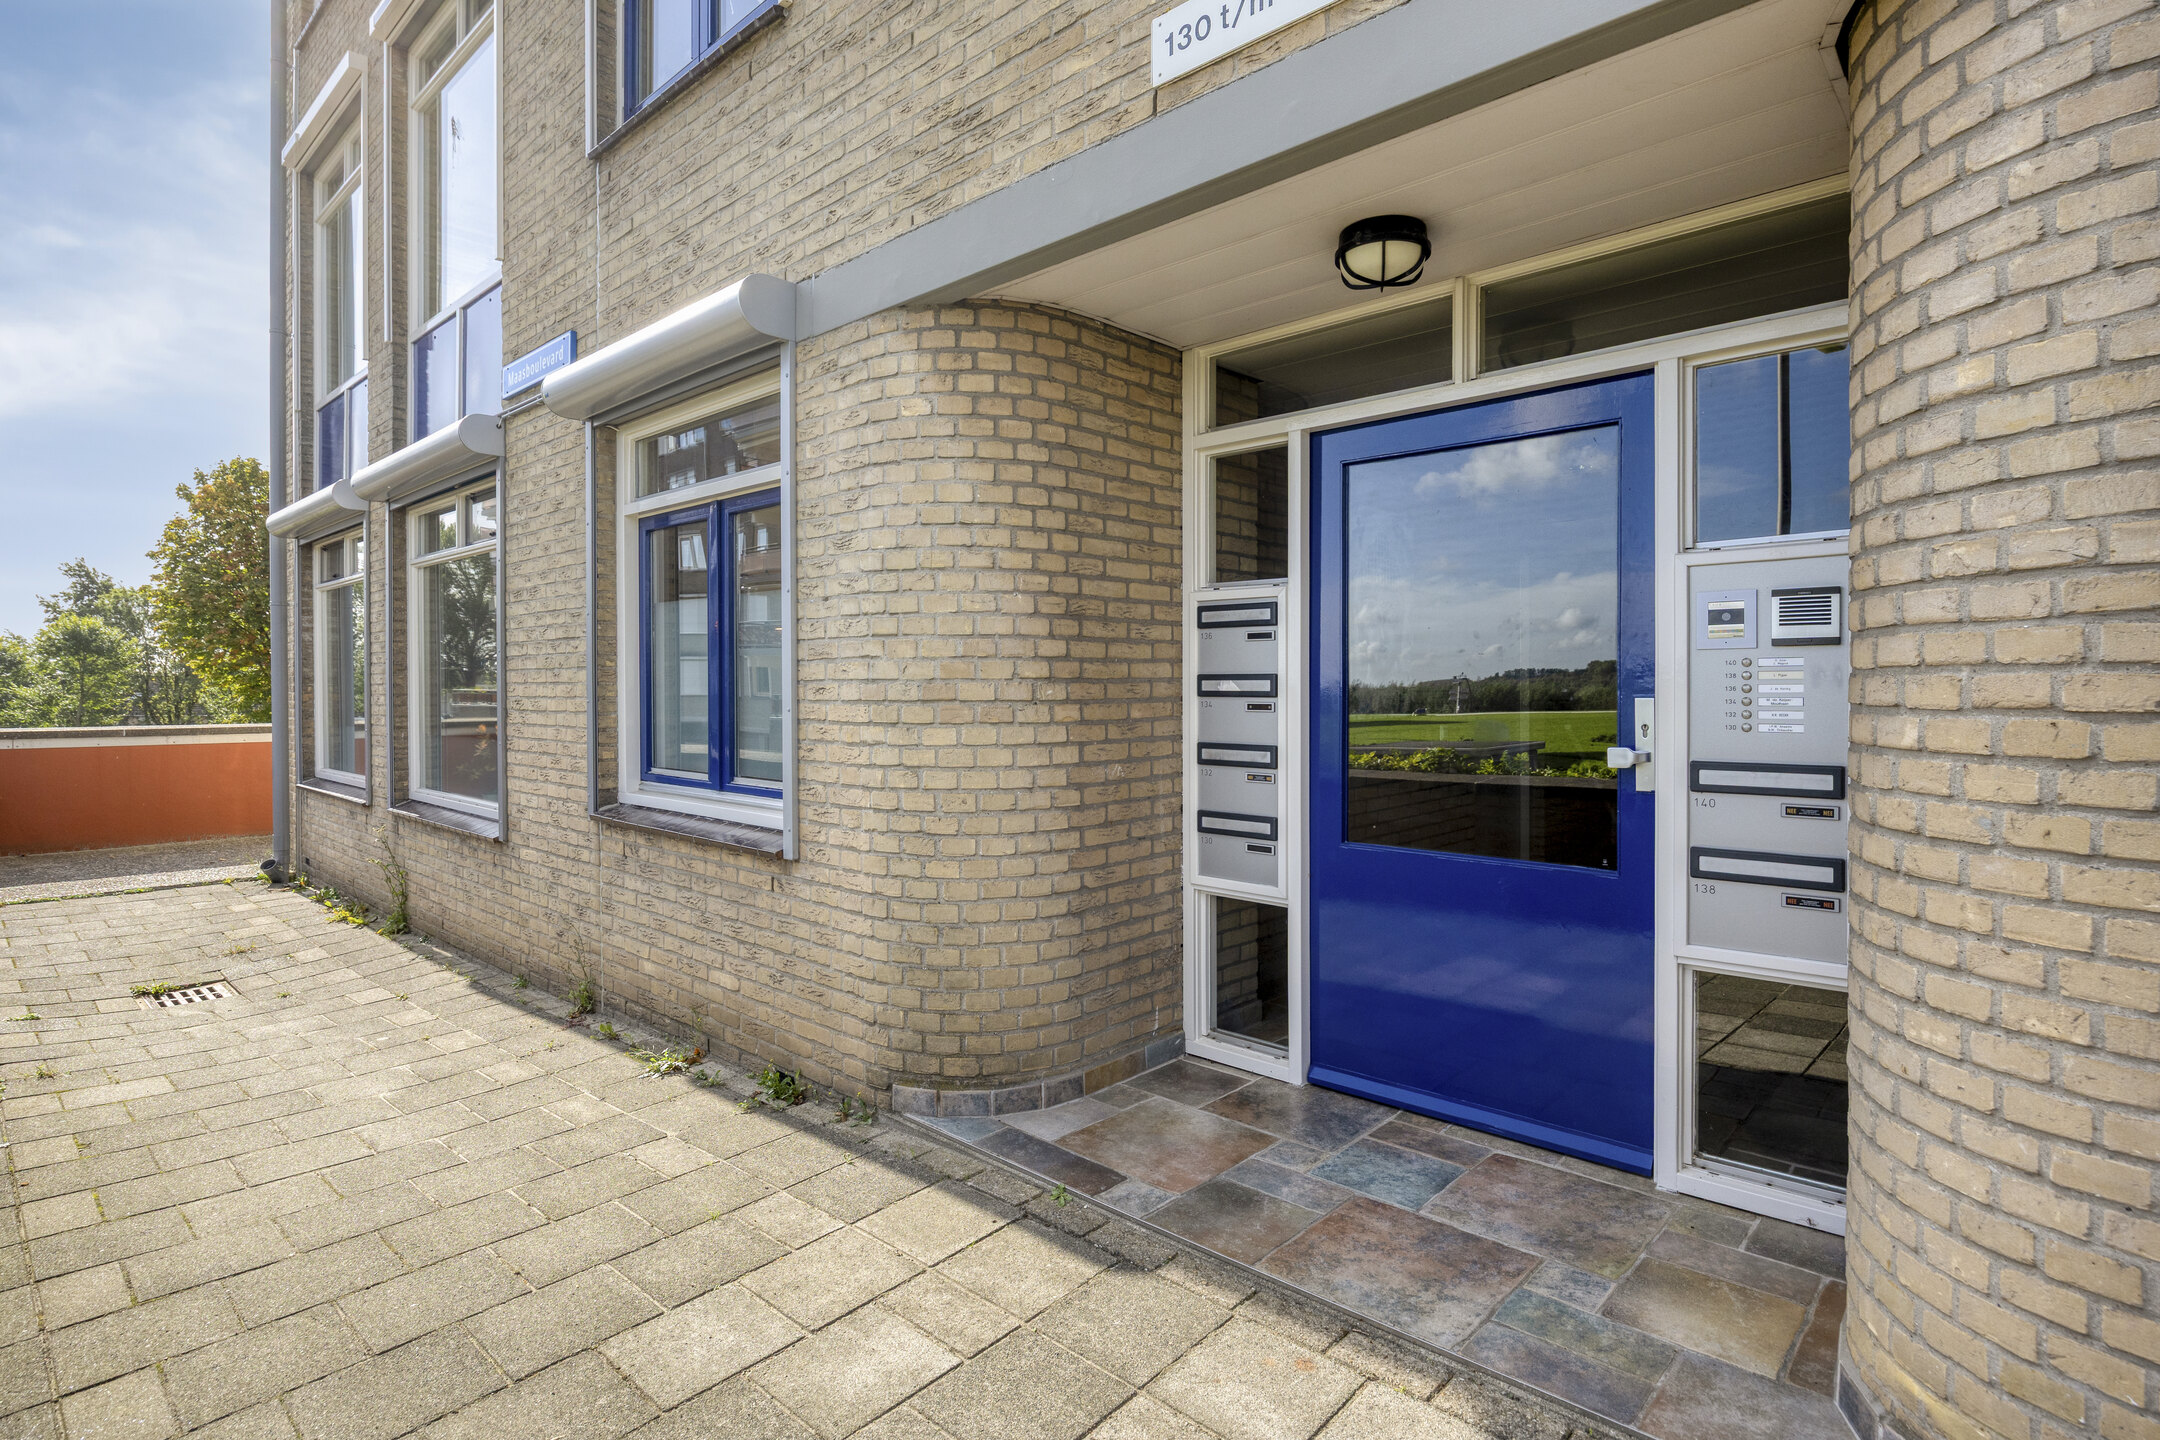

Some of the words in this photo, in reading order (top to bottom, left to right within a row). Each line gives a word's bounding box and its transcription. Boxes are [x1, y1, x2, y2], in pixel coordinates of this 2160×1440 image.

[1164, 15, 1212, 57] 130
[507, 344, 564, 388] Maasboulevard
[1200, 700, 1213, 708] 134
[1200, 768, 1213, 777] 132
[1694, 797, 1716, 808] 140
[1200, 836, 1213, 845] 130
[1694, 883, 1716, 895] 138
